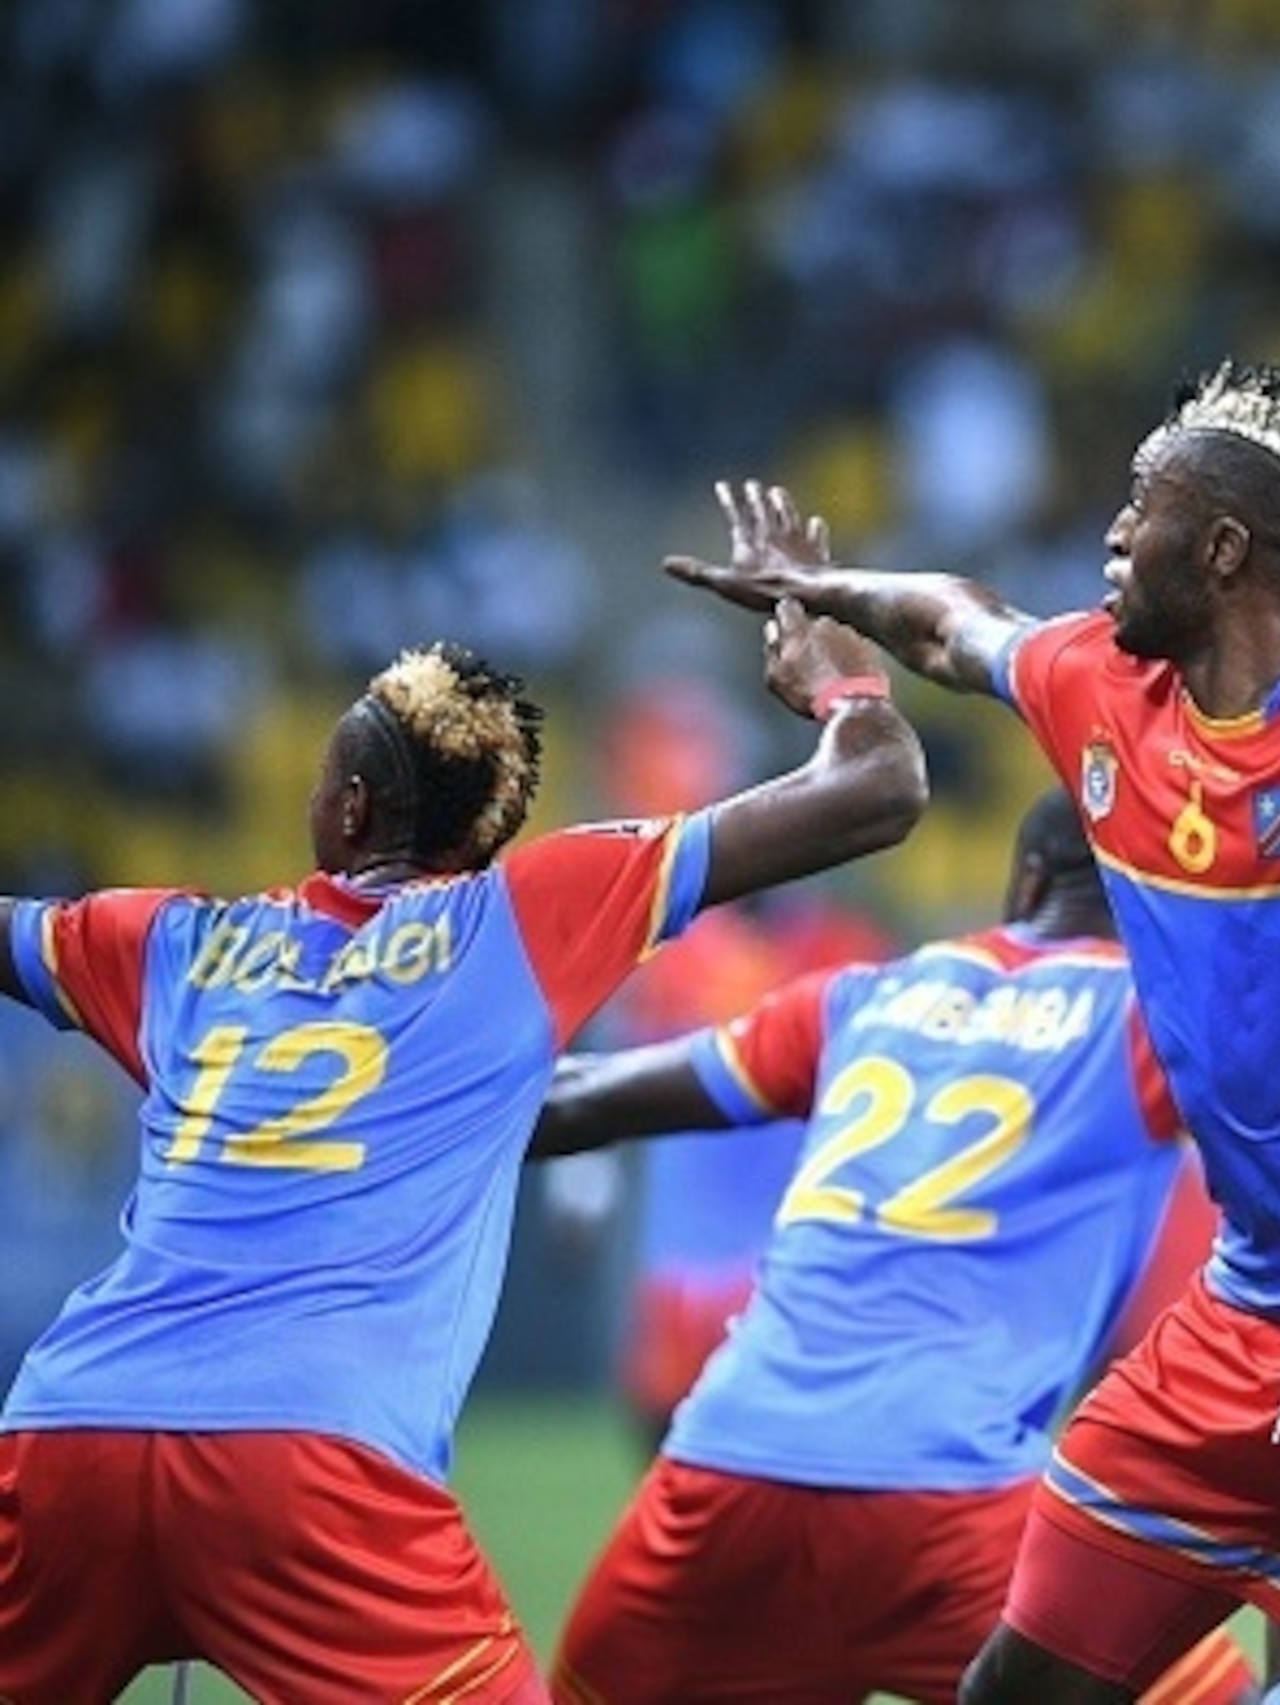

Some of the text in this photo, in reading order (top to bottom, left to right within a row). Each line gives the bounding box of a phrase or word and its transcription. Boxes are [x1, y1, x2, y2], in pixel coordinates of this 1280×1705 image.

[1168, 780, 1217, 874] 6
[165, 1020, 391, 1173] 12
[776, 1055, 1035, 1243] 22
